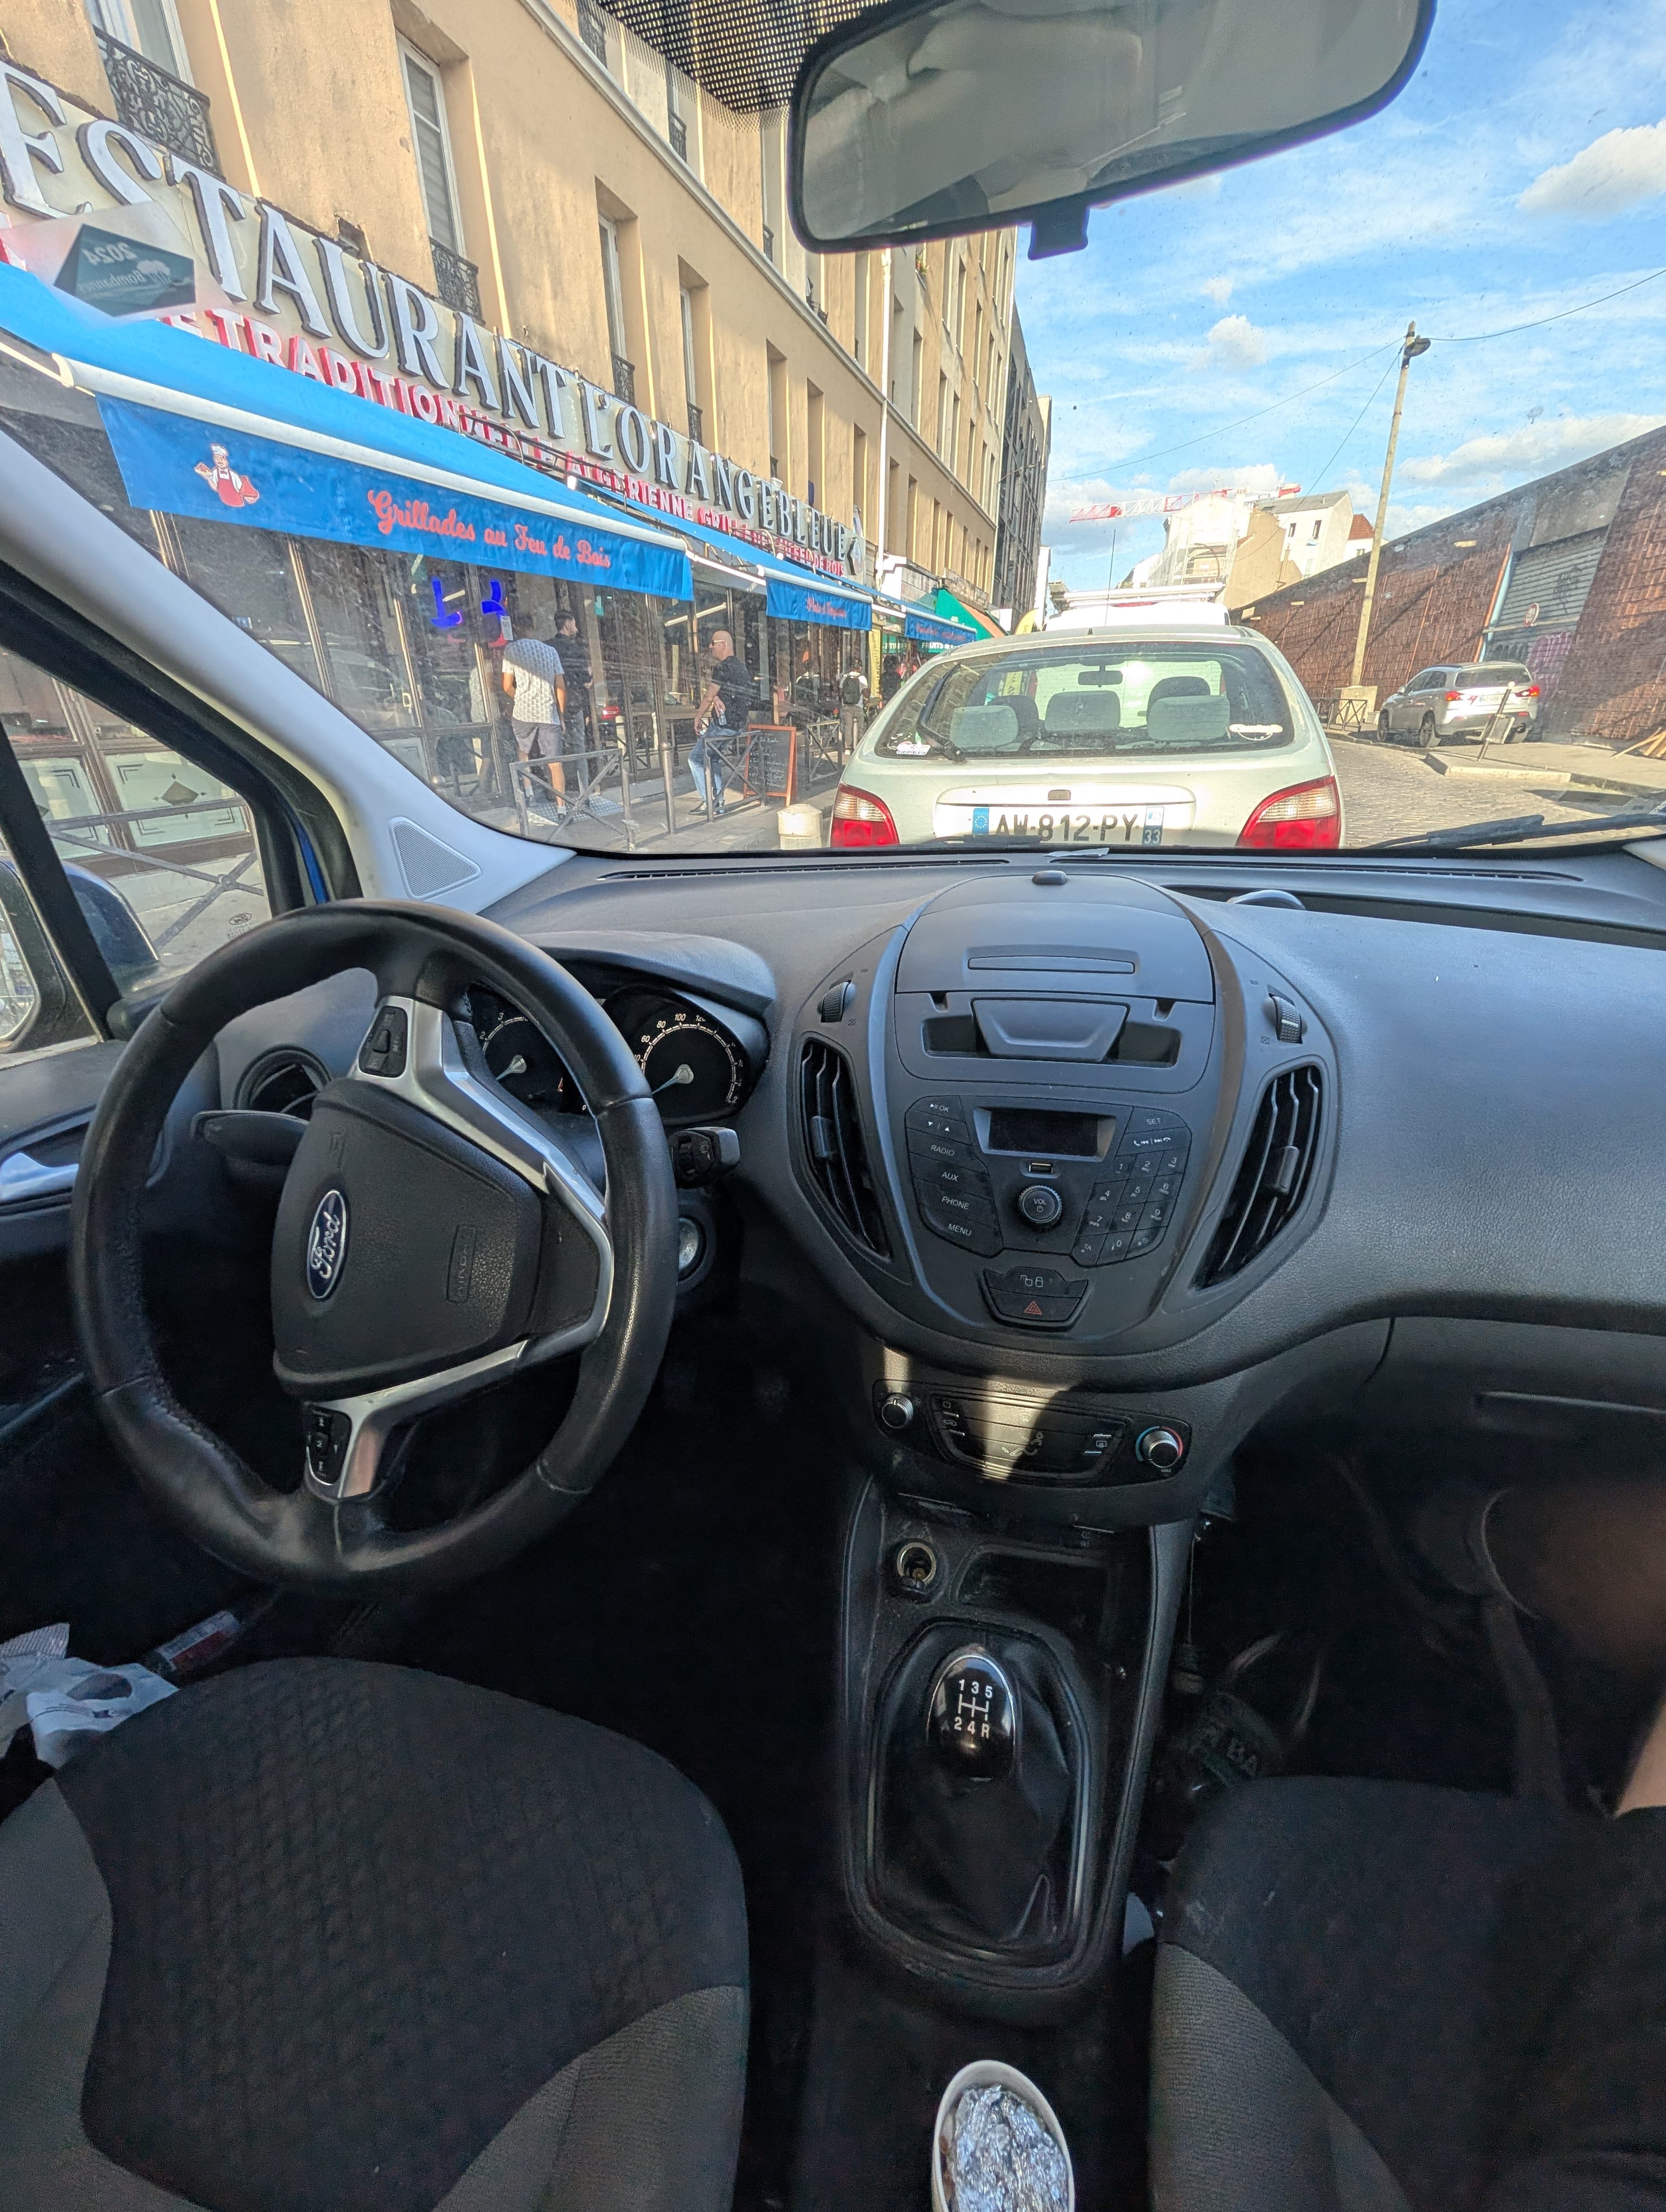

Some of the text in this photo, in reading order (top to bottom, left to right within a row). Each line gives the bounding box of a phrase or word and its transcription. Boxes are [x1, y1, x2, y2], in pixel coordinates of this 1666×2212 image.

[367, 489, 612, 569] Grillades au Feu de Bois
[995, 813, 1138, 842] AW-812-PY
[1144, 828, 1161, 845] 33
[497, 1012, 504, 1021] 3
[674, 1013, 687, 1021] 100
[656, 1020, 667, 1028] 80
[479, 1031, 486, 1039] 2
[640, 1035, 651, 1043] 60
[939, 1104, 950, 1113] OK
[931, 1144, 955, 1156] RADIO
[941, 1171, 959, 1182] AUX
[941, 1196, 970, 1210] PHONE
[947, 1223, 972, 1237] MENU
[310, 1211, 340, 1279] Ford
[1116, 1239, 1123, 1248] 0
[958, 1679, 993, 1699] 1 3 5
[953, 1716, 990, 1739] 2 4 R
